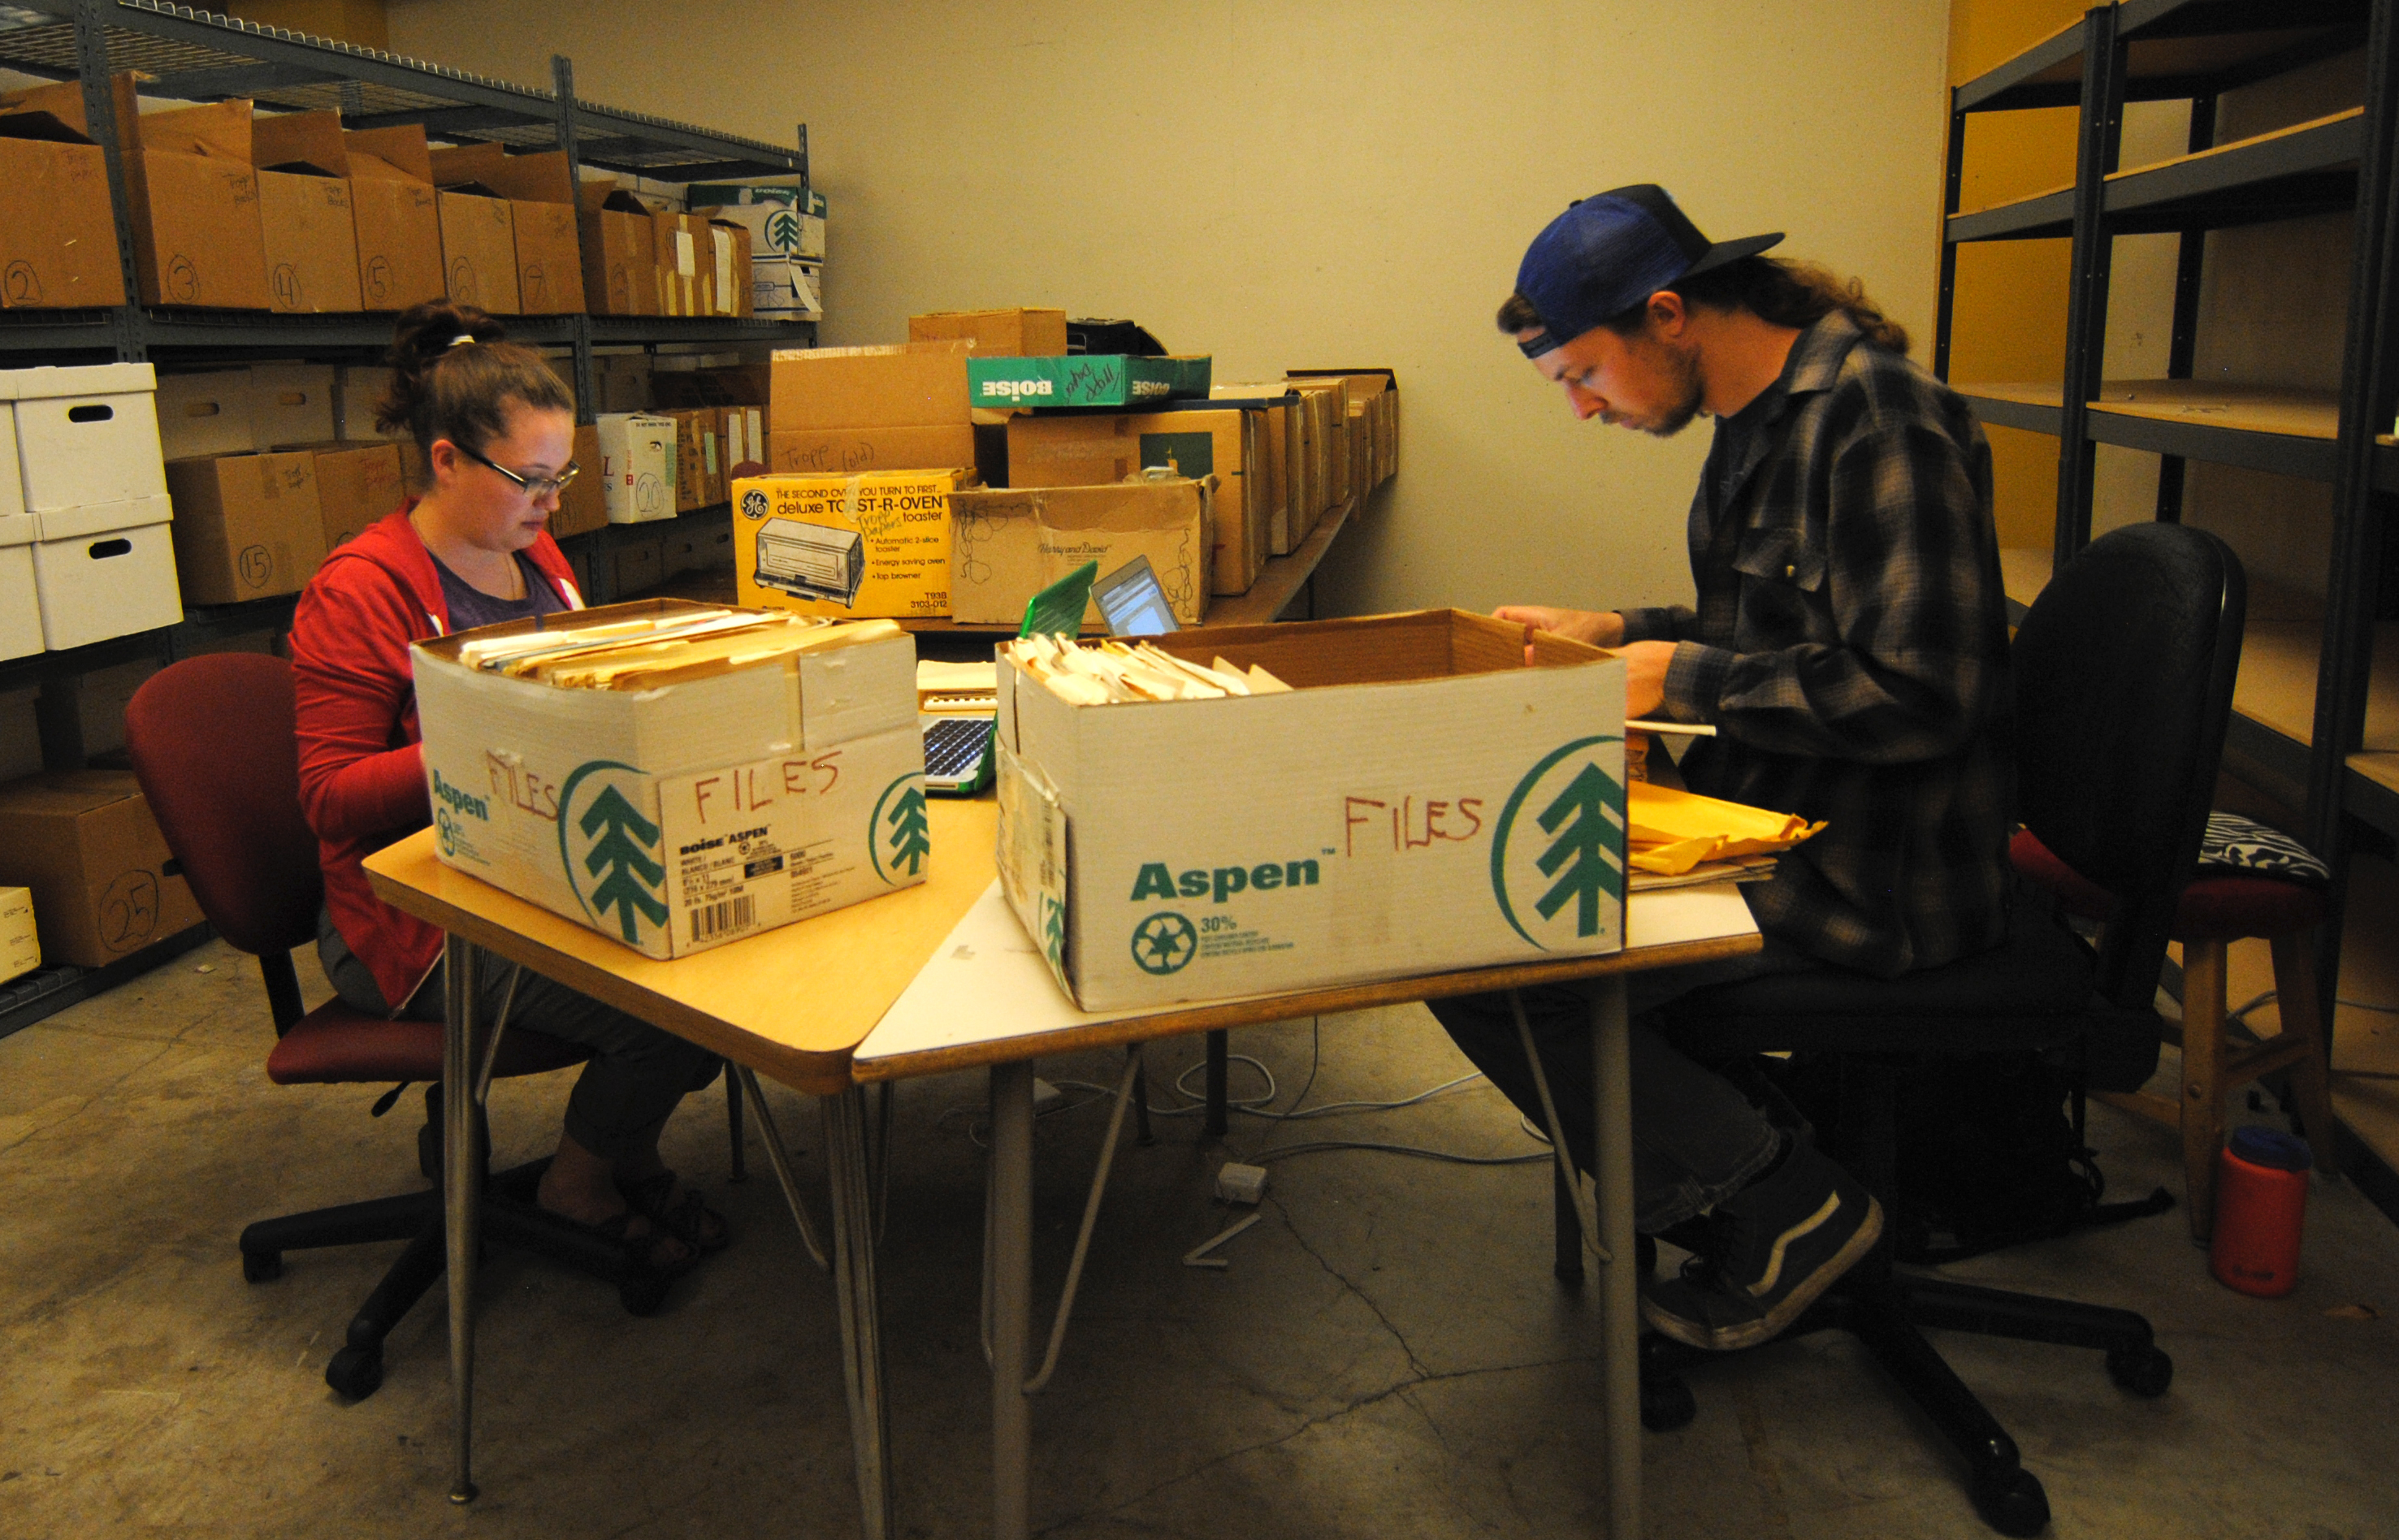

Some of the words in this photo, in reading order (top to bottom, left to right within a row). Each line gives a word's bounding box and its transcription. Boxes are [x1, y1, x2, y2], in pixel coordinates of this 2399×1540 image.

[777, 490, 791, 500] THE
[792, 489, 828, 499] SECOND
[860, 487, 877, 496] YOU
[879, 486, 902, 495] TURN
[904, 485, 916, 495] TO
[777, 501, 824, 515] deluxe
[903, 510, 943, 523] toaster
[875, 537, 914, 545] Automatic
[916, 536, 940, 544] 2-slice
[1067, 547, 1083, 556] and
[245, 552, 267, 579] 15
[876, 559, 900, 567] Energy
[877, 573, 890, 581] Top
[910, 600, 948, 608] 3103-012
[486, 749, 559, 822] FILES
[695, 750, 842, 825] FILES
[433, 768, 490, 822] Aspen
[1345, 794, 1483, 858] FILES
[729, 826, 769, 845] ASPEN
[1130, 859, 1319, 904] Aspen
[109, 882, 151, 944] 25
[1201, 915, 1237, 933] 30%
